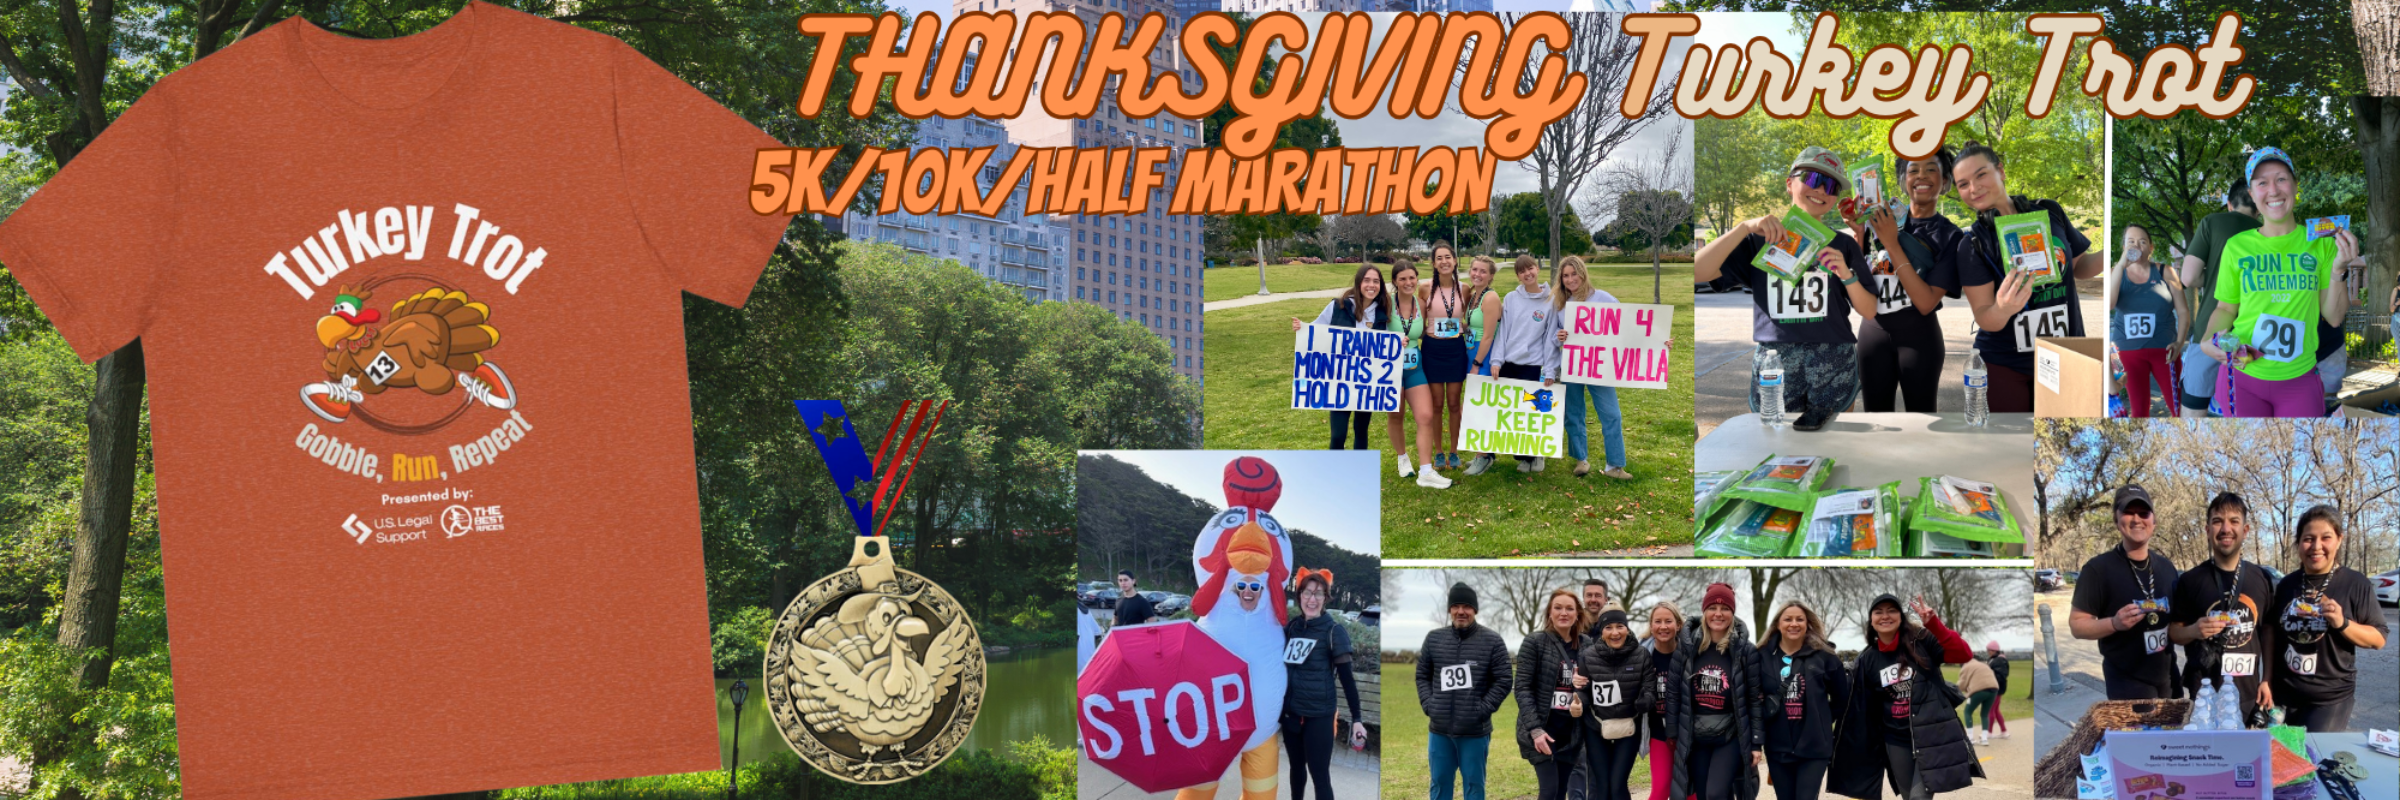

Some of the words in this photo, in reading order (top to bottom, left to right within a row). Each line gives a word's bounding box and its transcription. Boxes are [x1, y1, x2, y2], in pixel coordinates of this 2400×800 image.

[263, 205, 434, 300] Turkey
[447, 202, 548, 295] Trot
[1771, 276, 1824, 314] 143
[2271, 293, 2291, 303] 2022
[1574, 305, 1622, 336] RUN
[1636, 309, 1654, 337] 4
[2017, 309, 2069, 349] 145
[2128, 316, 2151, 335] 55
[1307, 325, 1315, 351] I
[1328, 327, 1403, 361] TRAINED
[2260, 319, 2297, 358] 29
[370, 356, 395, 380] 13
[1294, 351, 1372, 384] MONTHS
[1377, 361, 1394, 384] 2
[1563, 344, 1606, 379] THE
[1612, 347, 1668, 383] VILLA
[1294, 379, 1350, 409] HOLD
[1354, 385, 1397, 411] THIS
[1470, 382, 1523, 409] JUST
[1496, 409, 1556, 434] KEEP
[295, 423, 383, 483] Gobble,
[449, 409, 533, 473] Repeat
[1465, 428, 1557, 457] RUNNING
[381, 488, 449, 505] Presented
[453, 487, 474, 501] by:
[374, 517, 396, 529] U.S.
[398, 514, 433, 527] Legal
[472, 505, 501, 515] THE
[474, 515, 504, 526] BEST
[376, 530, 427, 543] Support
[1288, 638, 1312, 660] 134
[1444, 667, 1467, 688] 39
[2224, 657, 2254, 674] 061
[1594, 684, 1615, 704] 37
[1082, 673, 1245, 760] STOP
